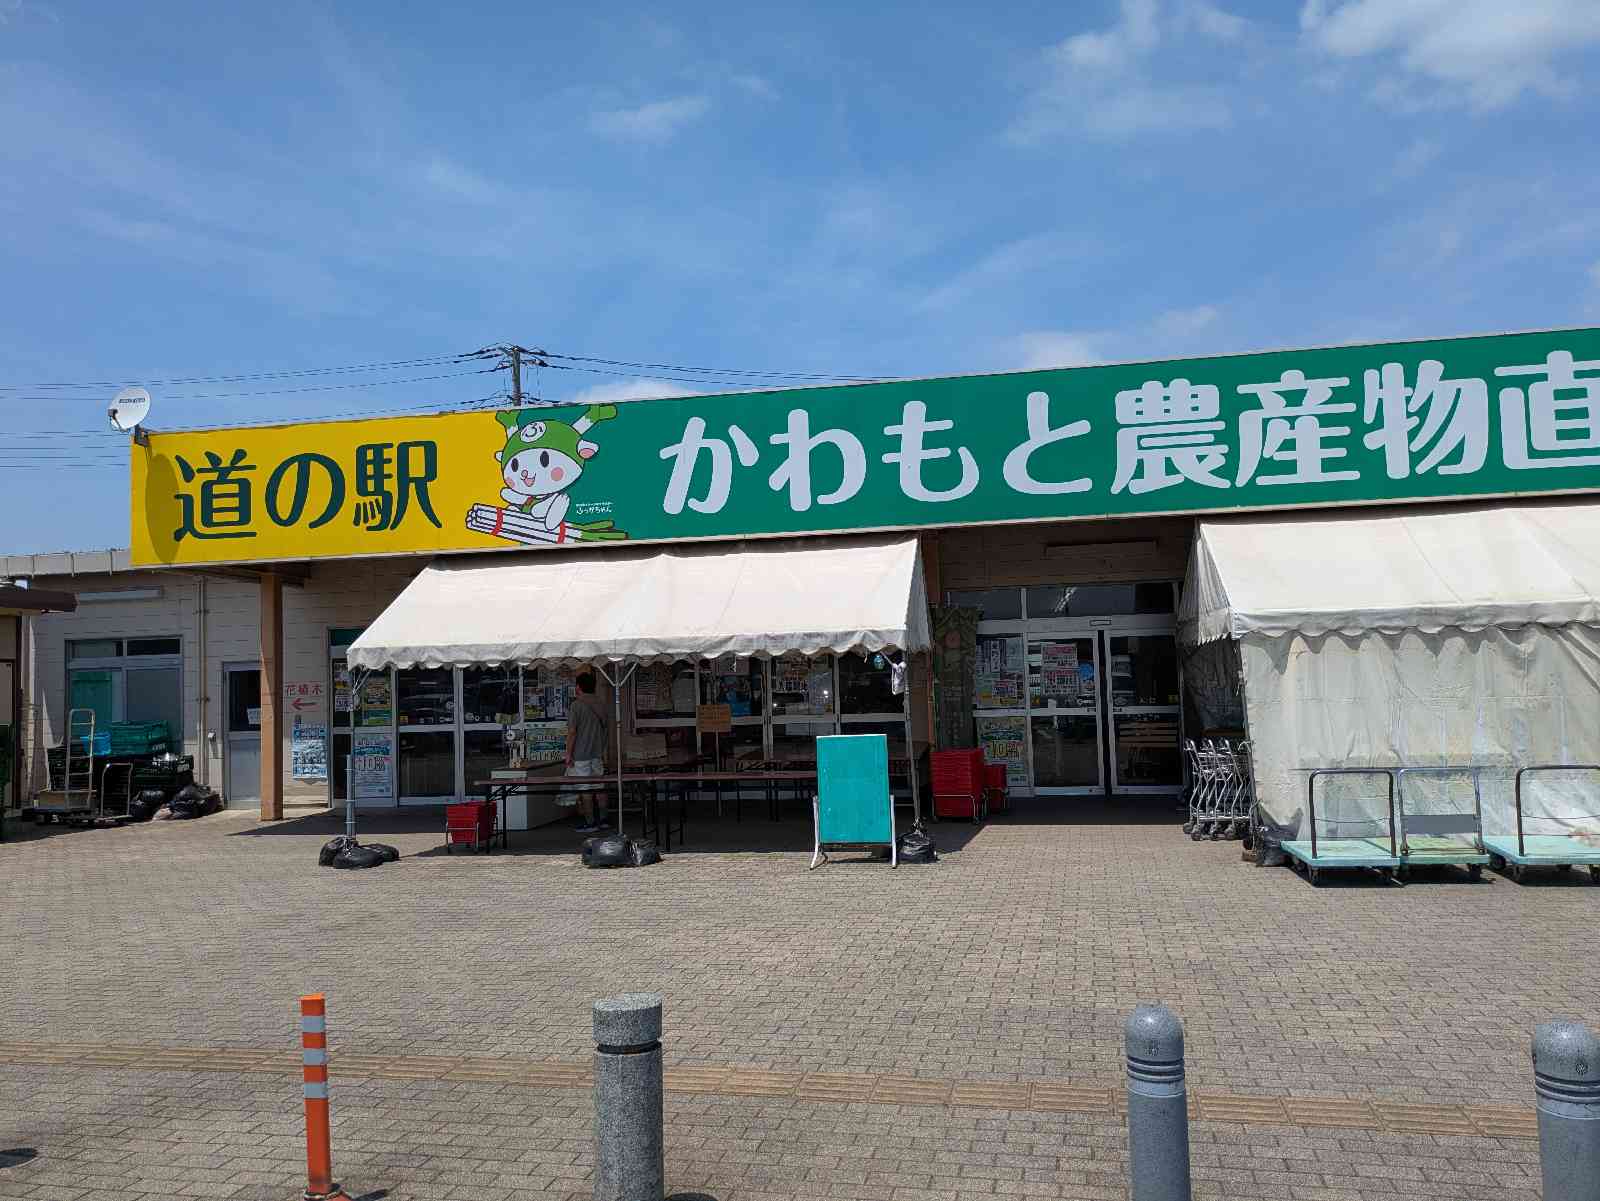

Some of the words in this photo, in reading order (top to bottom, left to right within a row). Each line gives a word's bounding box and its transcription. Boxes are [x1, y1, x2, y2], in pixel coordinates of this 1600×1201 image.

[173, 440, 443, 543] 道の駅
[659, 350, 1600, 515] かわもと農産物直
